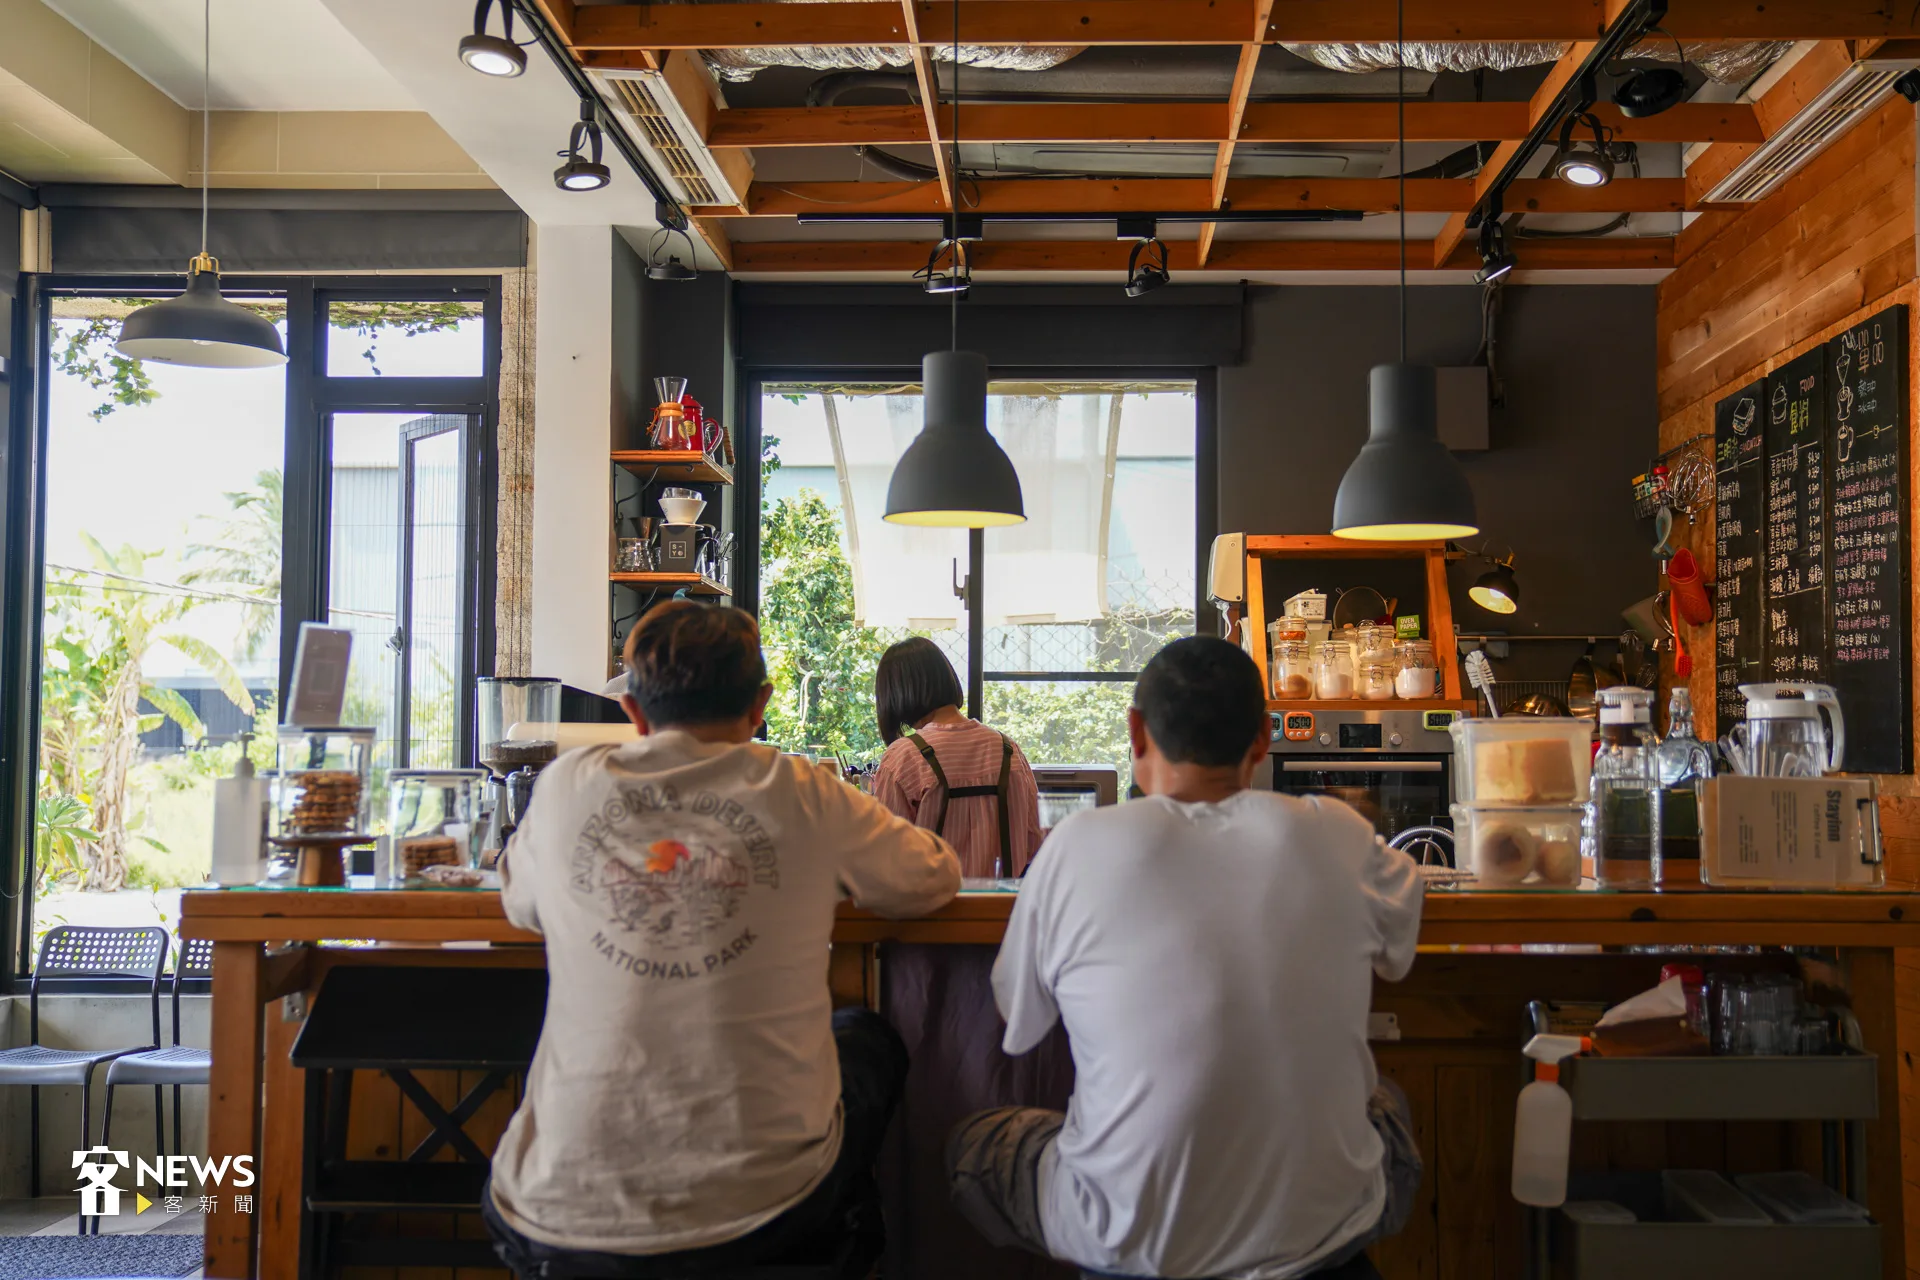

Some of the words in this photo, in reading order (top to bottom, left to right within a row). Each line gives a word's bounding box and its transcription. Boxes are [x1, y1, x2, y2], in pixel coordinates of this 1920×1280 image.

[1400, 617, 1415, 625] OVEN
[691, 790, 780, 890] DESERT
[1825, 790, 1843, 842] Stayinn
[590, 931, 700, 981] NATIONAL
[703, 926, 759, 973] PARK
